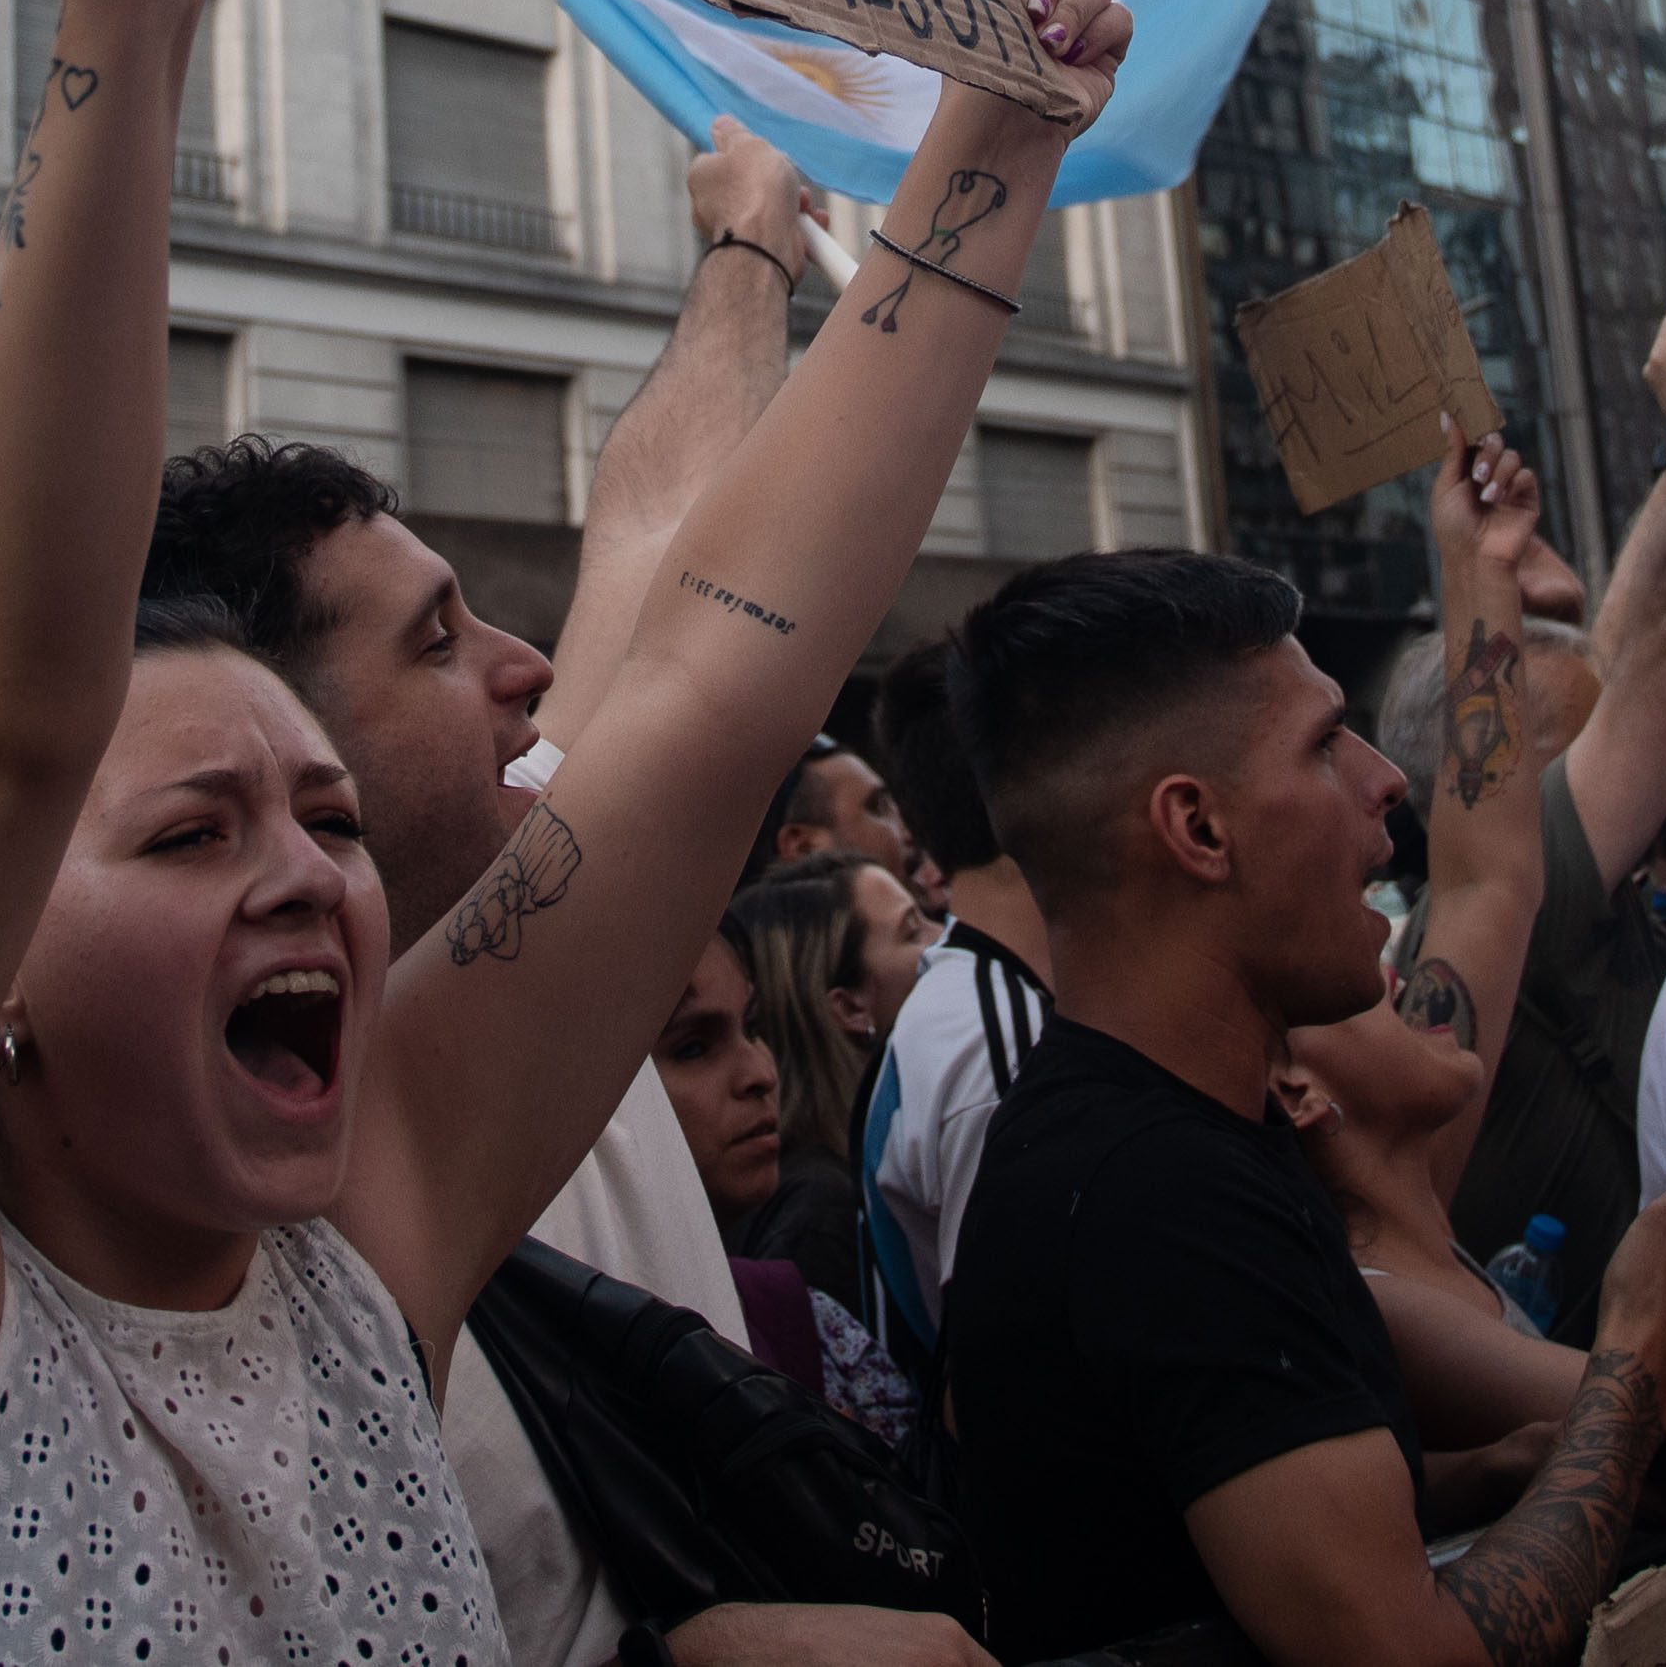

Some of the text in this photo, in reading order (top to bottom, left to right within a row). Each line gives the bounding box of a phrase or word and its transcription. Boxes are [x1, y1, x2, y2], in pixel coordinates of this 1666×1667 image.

[679, 570, 797, 636] Jeremías 33:3
[852, 1519, 947, 1581] SPORT
